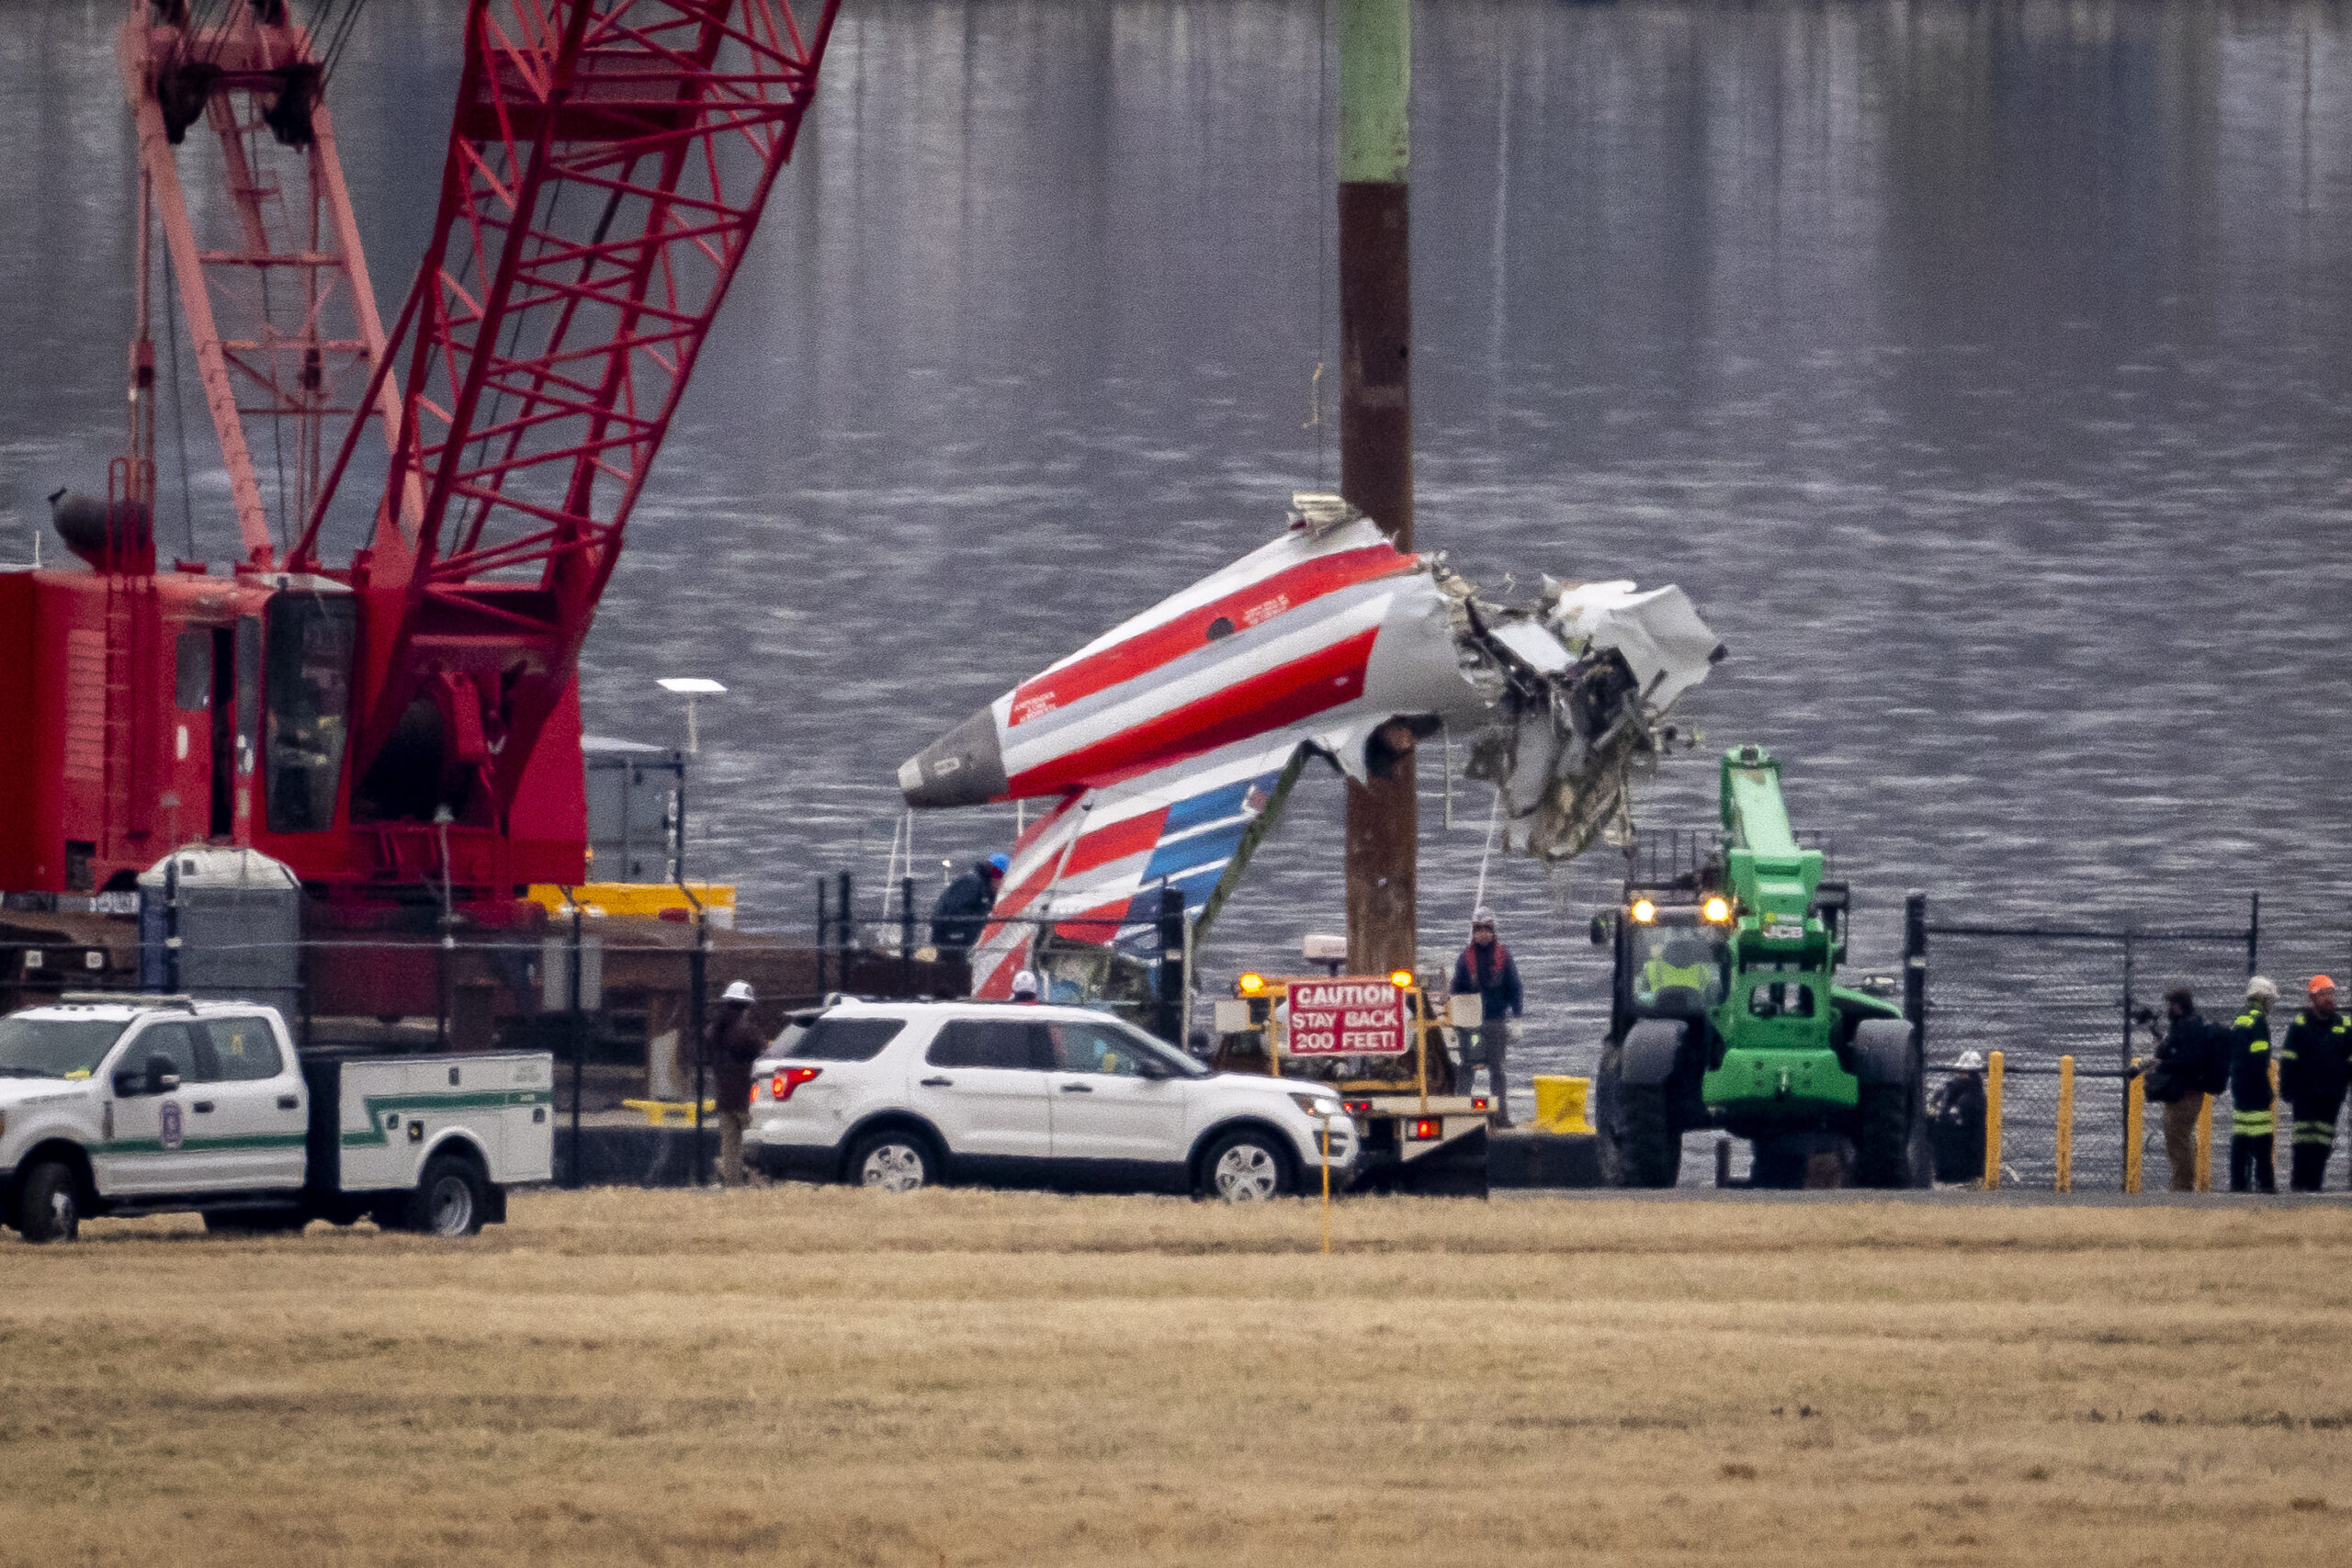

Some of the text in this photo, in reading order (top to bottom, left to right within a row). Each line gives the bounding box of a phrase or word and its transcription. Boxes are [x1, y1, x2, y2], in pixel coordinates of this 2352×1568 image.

[1296, 985, 1396, 1005] CAUTION
[1292, 1009, 1398, 1029] STAY BACK
[1295, 1031, 1396, 1049] 200 FEET!
